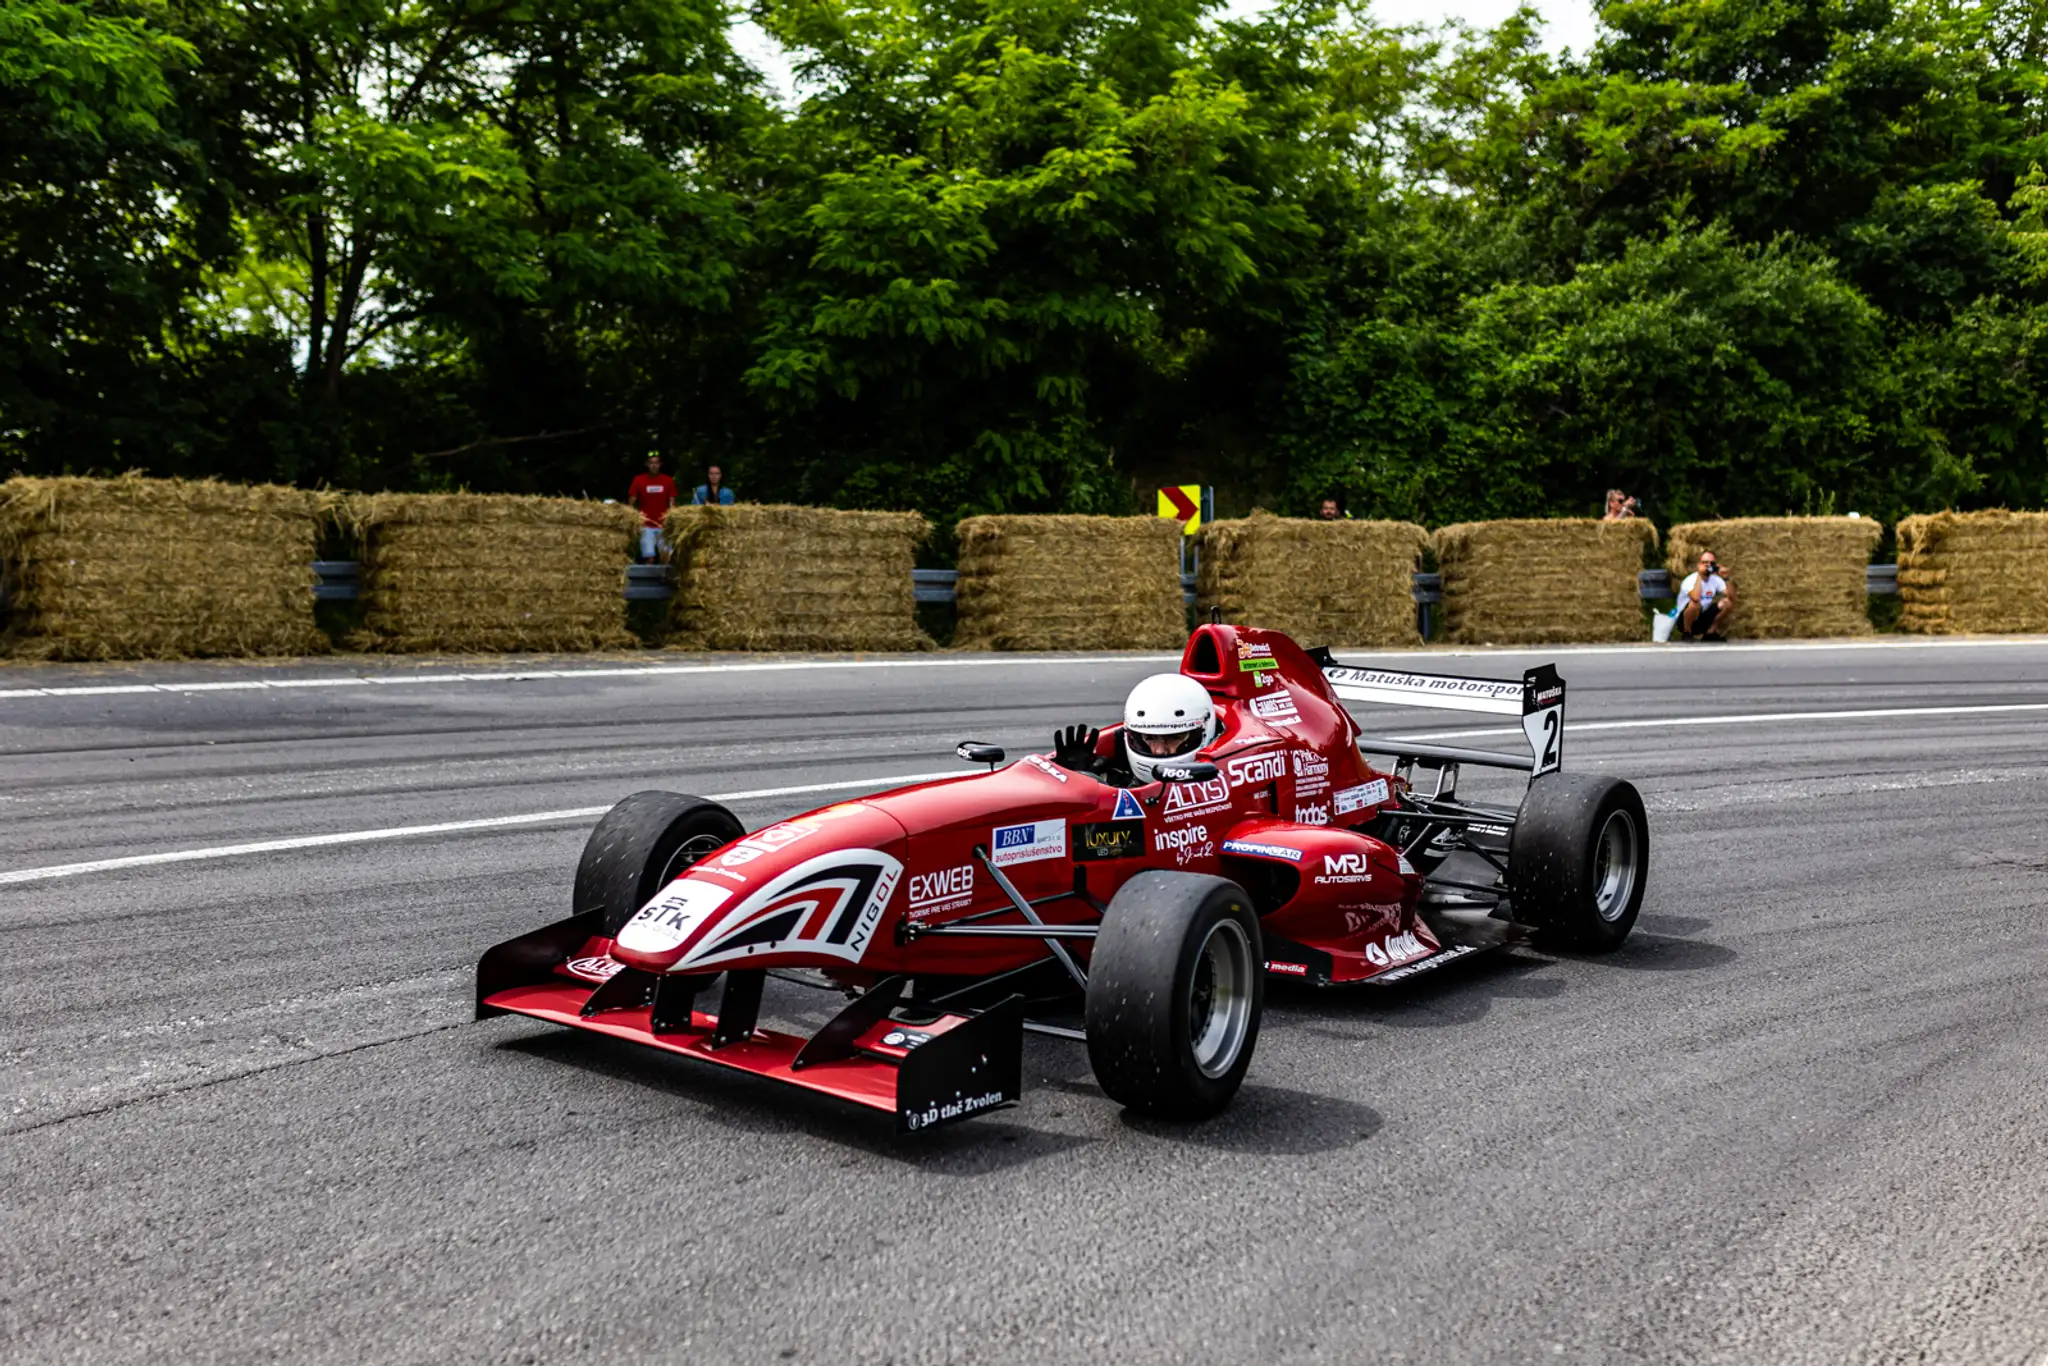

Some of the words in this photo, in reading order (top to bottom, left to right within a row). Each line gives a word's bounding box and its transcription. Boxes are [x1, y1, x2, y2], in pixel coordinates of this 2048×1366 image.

[1350, 669, 1426, 688] Matuška
[1429, 679, 1524, 698] motorspor
[1541, 710, 1558, 767] 2
[1162, 767, 1192, 779] IGOL
[1228, 750, 1286, 788] Scandi
[1302, 762, 1329, 776] Harmony
[1164, 778, 1224, 809] ALTYS
[1001, 827, 1030, 847] BBN
[1154, 822, 1208, 853] inspire
[1223, 841, 1300, 861] PROFINCAR
[1323, 853, 1367, 875] MRJ
[909, 865, 974, 902] EXWEB
[637, 904, 692, 931] STK
[850, 869, 899, 953] NIGOL
[921, 1108, 939, 1128] 3D
[941, 1101, 963, 1119] tlač
[964, 1091, 1002, 1112] Zvolen
